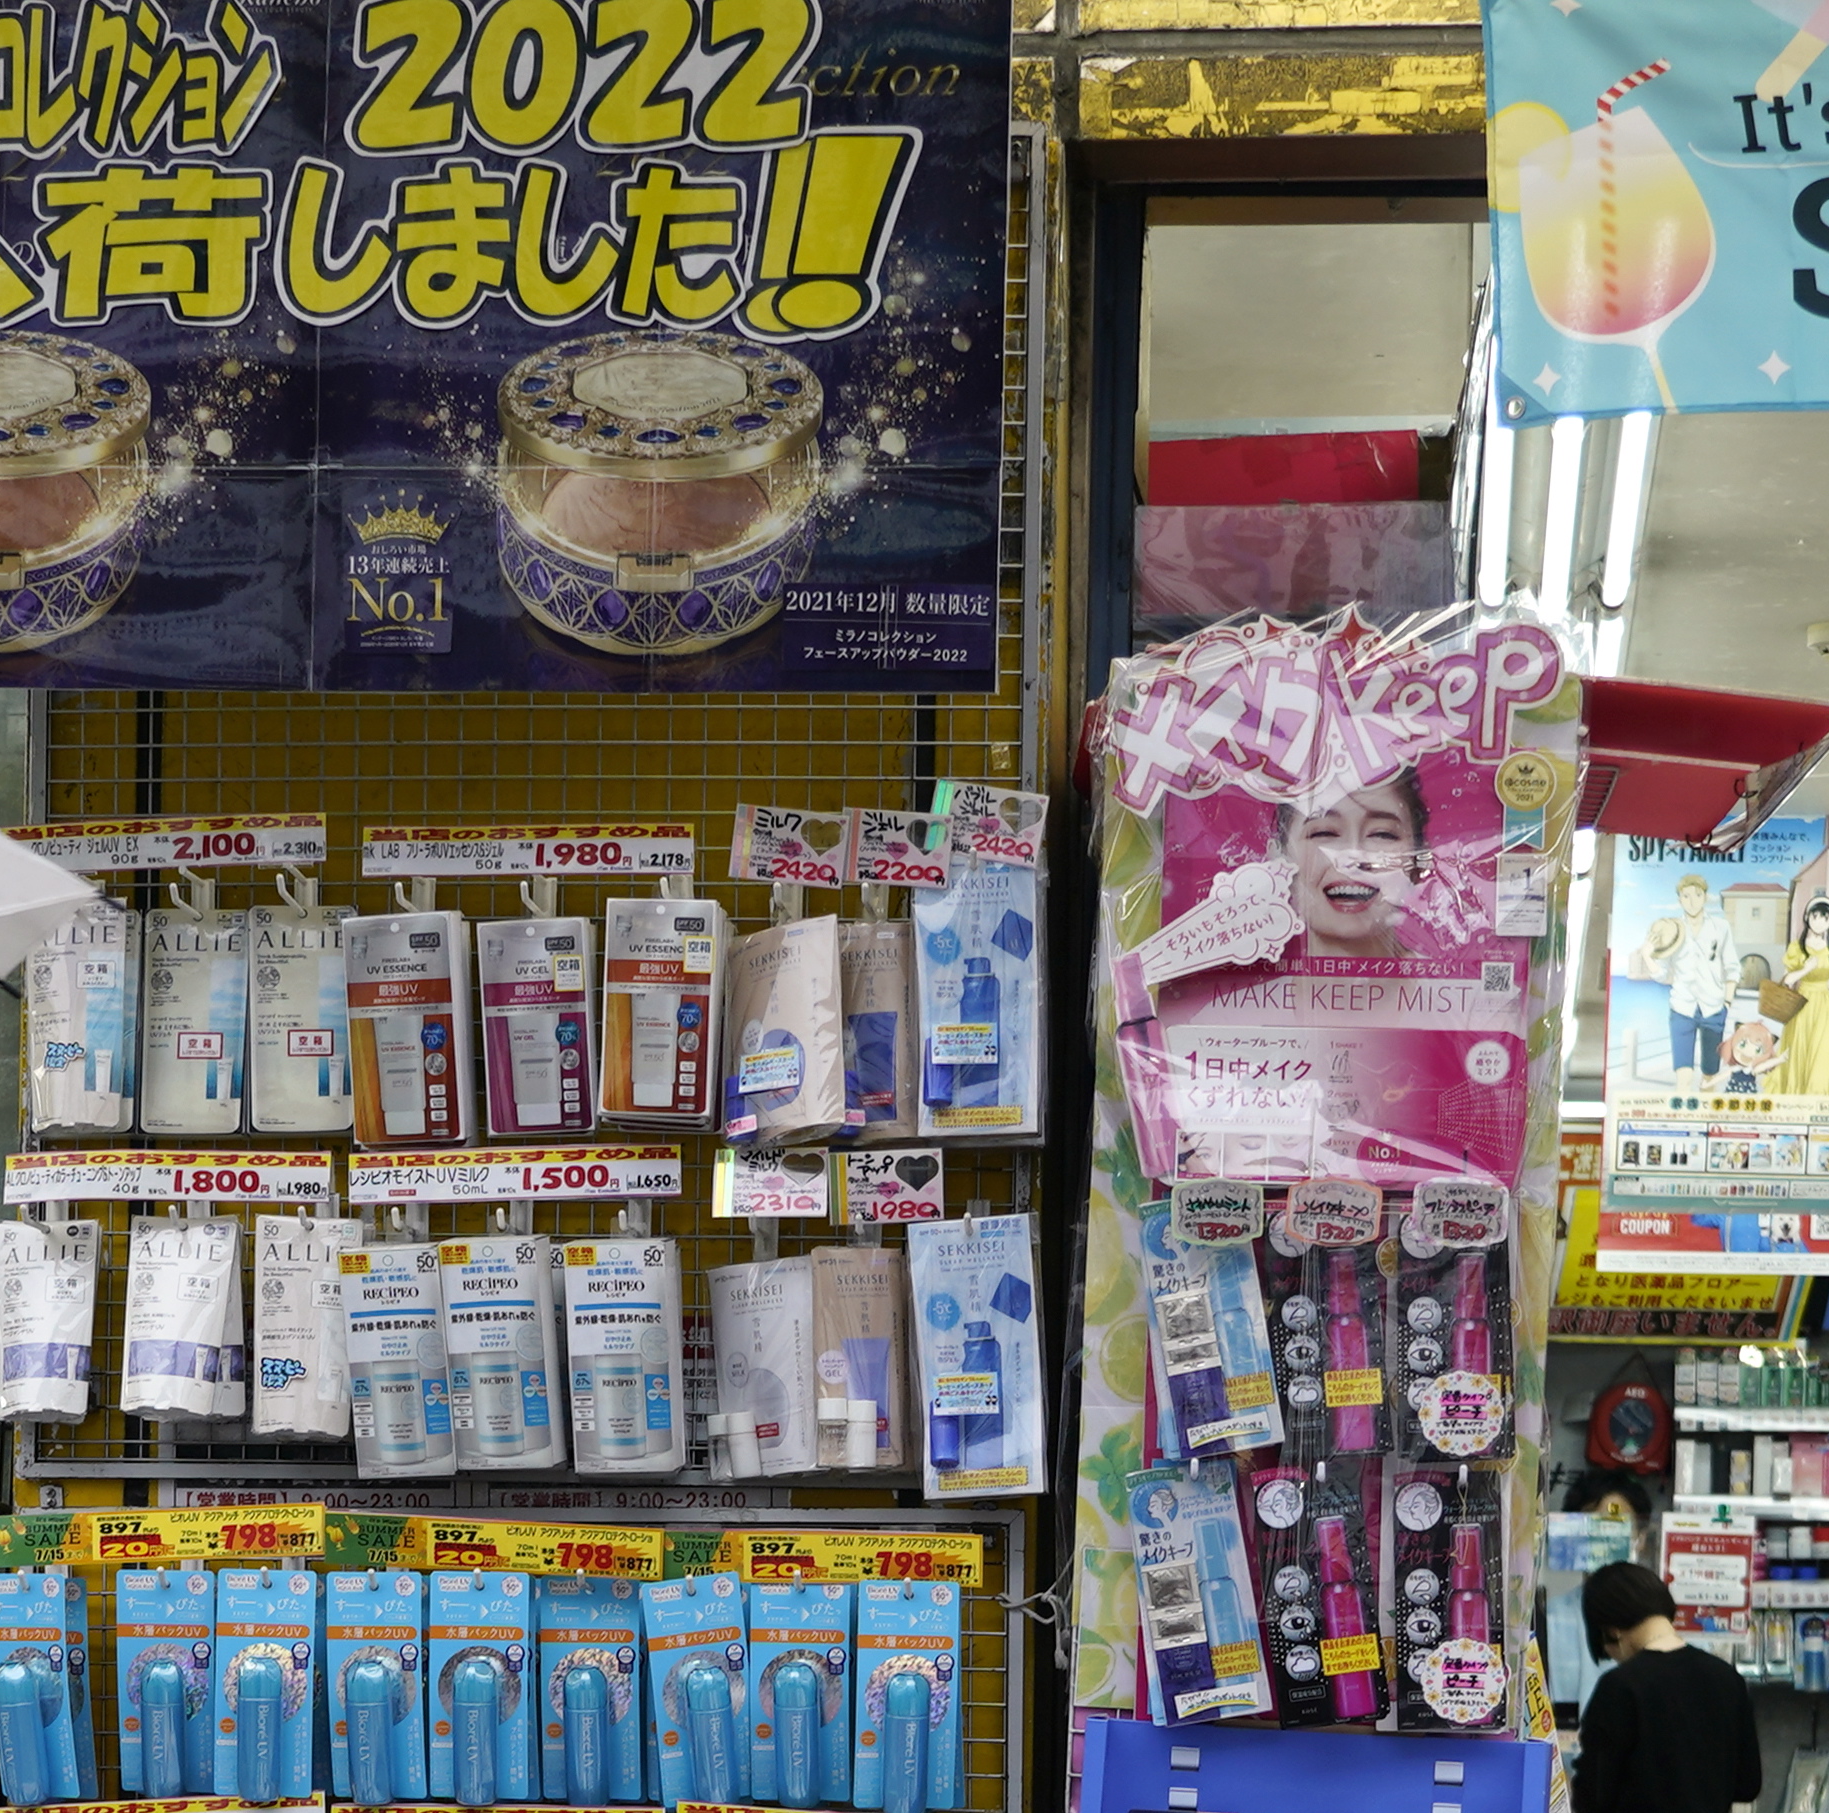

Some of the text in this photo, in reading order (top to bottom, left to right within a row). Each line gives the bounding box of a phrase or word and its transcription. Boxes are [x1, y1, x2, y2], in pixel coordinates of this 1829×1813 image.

[350, 0, 812, 152] 2022
[347, 555, 450, 576] 13年連続売上
[347, 577, 450, 623] No.1
[785, 590, 990, 618] 2021年12月 数量限定
[835, 629, 937, 645] ミラノコレクション
[151, 928, 243, 953] ALLIE
[383, 961, 428, 974] ESSENCE
[1211, 984, 1473, 1013] MAKE KEEP MIST
[1185, 1050, 1312, 1081] 1日中メイク
[1620, 1219, 1670, 1235] COUPON
[137, 1240, 222, 1262] ALLIE
[938, 1241, 1006, 1257] SEKKISEI
[837, 1273, 889, 1286] SEKKISEI
[220, 1524, 276, 1551] 798
[556, 1542, 613, 1569] 798
